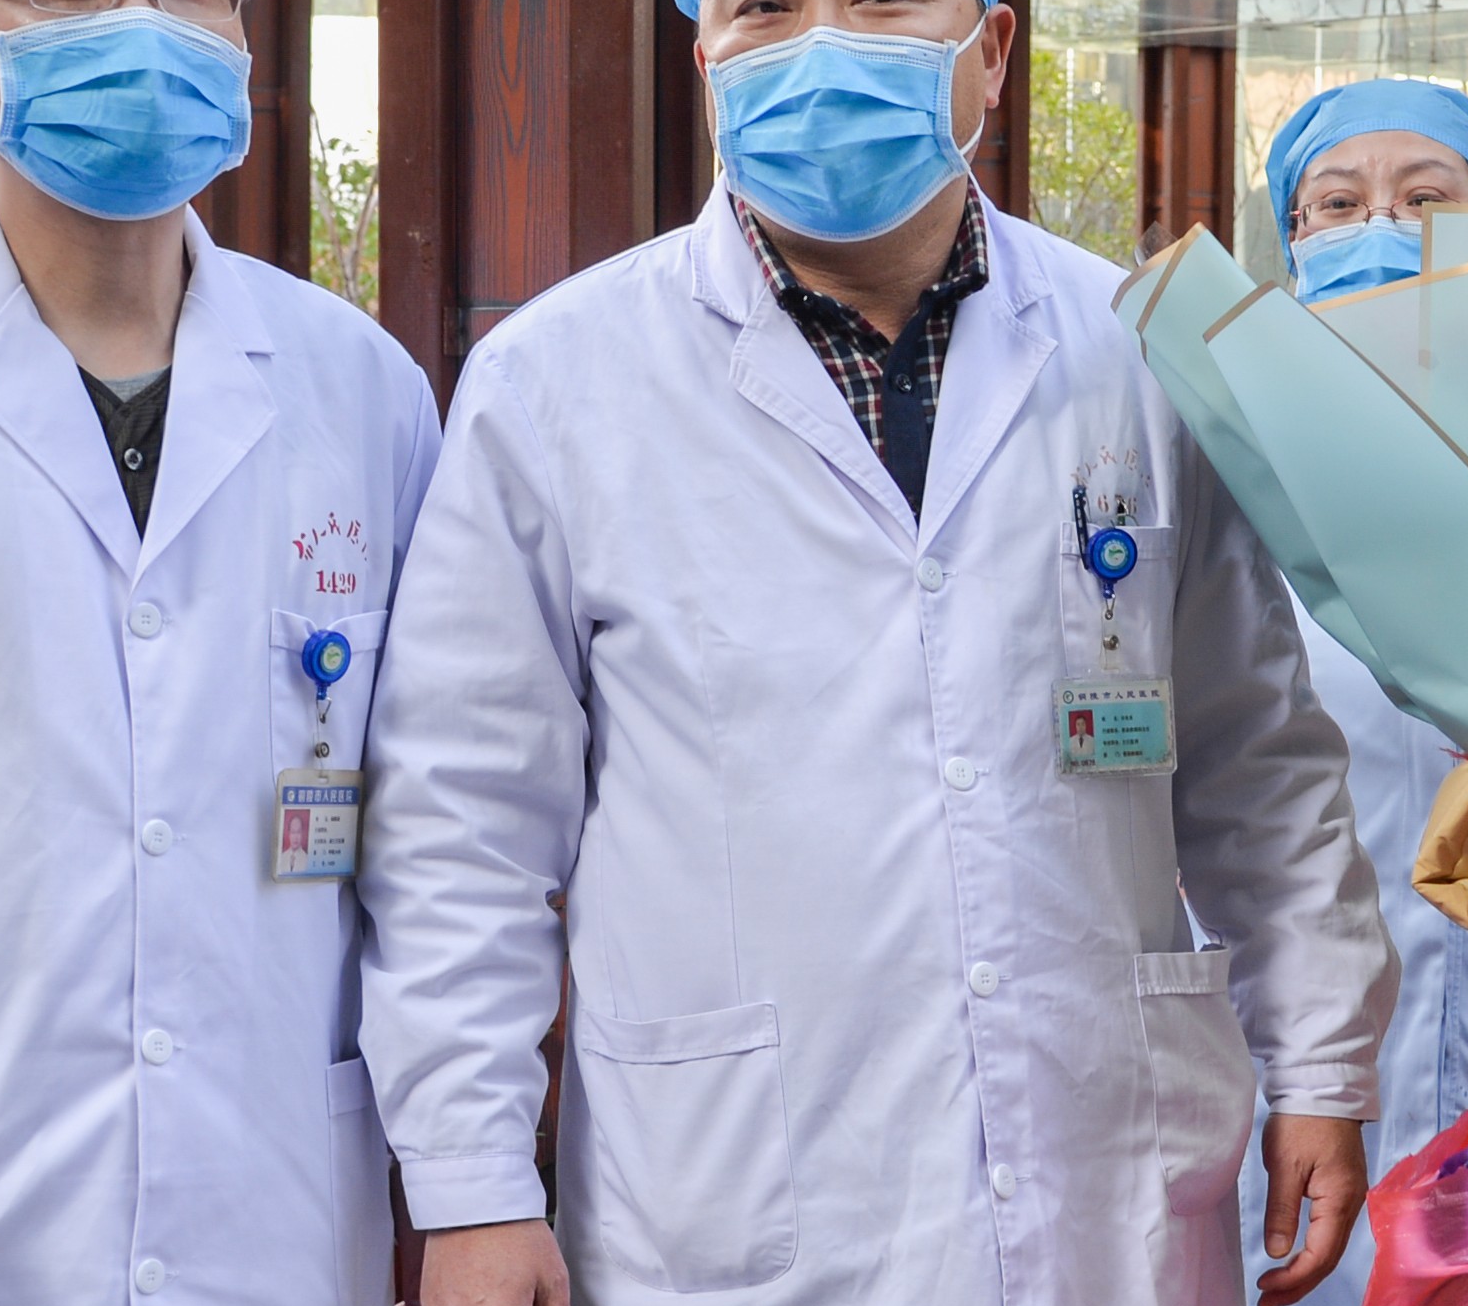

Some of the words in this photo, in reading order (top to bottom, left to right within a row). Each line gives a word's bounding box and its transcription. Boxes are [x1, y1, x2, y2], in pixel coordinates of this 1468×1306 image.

[315, 569, 357, 594] 1429
[1077, 689, 1161, 701] 铜陵市人民医院
[298, 789, 354, 803] 铜陵市人民医院
